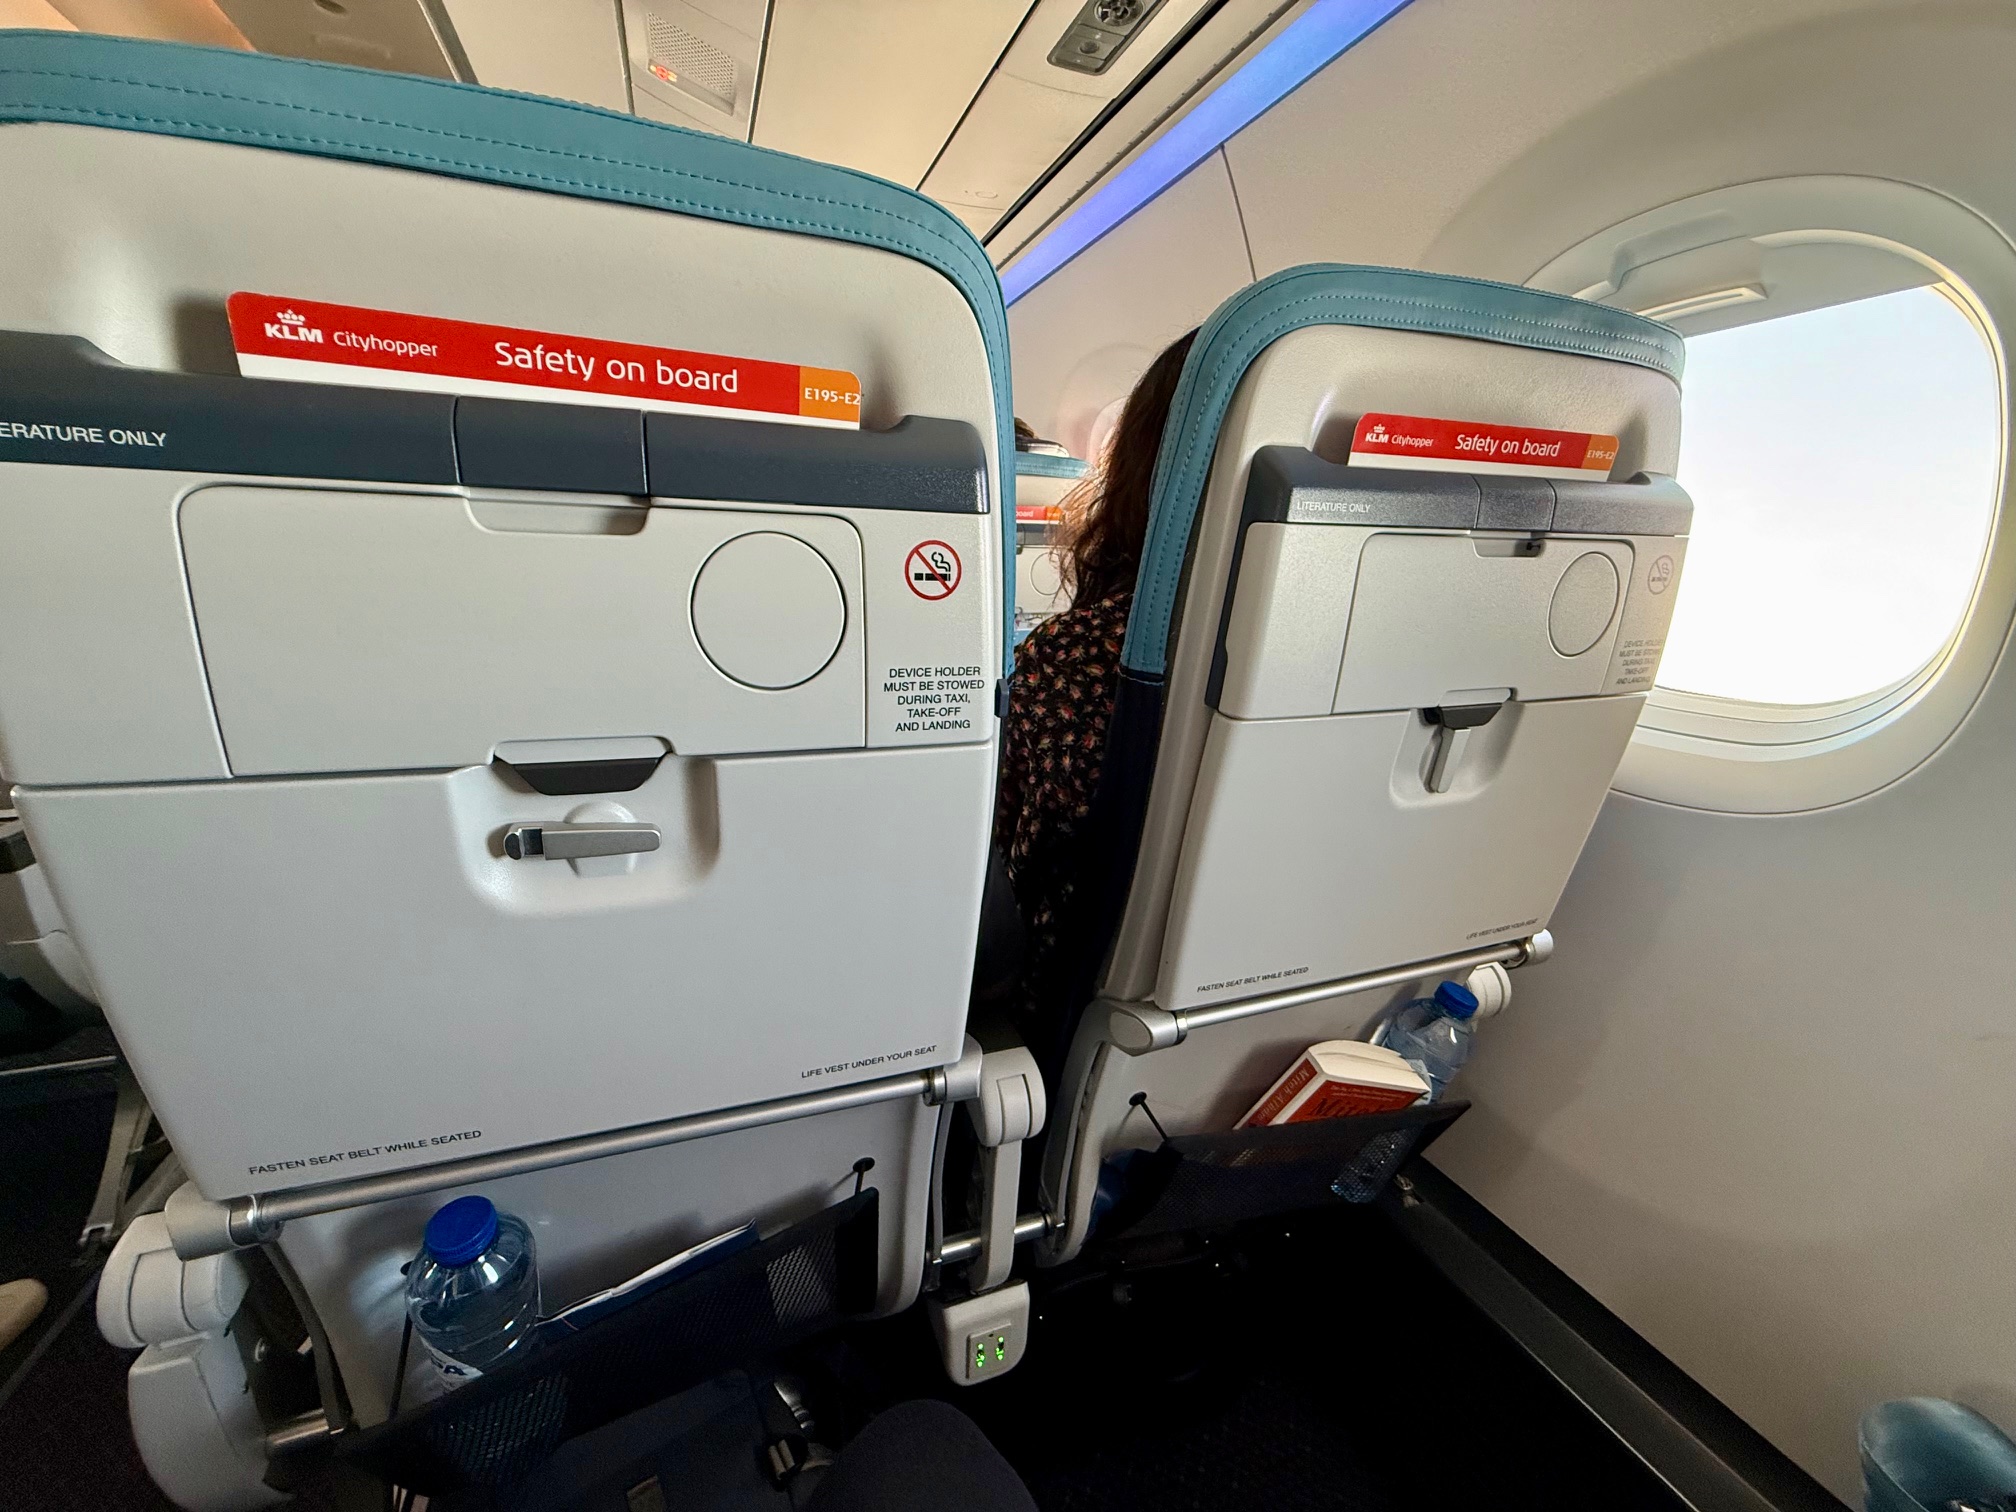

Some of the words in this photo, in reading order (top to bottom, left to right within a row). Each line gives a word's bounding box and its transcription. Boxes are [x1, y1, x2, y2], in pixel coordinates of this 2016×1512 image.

[264, 322, 324, 344] KLM
[333, 331, 438, 357] Cityhopper
[494, 341, 595, 382] Safety
[606, 358, 646, 383] on
[656, 359, 739, 393] board
[804, 387, 861, 406] E195-E2
[108, 429, 167, 447] ONLY
[1365, 431, 1389, 444] KLM
[1391, 434, 1434, 448] Cityhopper
[1454, 433, 1498, 456] Safety
[1501, 439, 1518, 454] on
[1521, 438, 1562, 458] board
[1586, 450, 1614, 460] E195-E2
[1296, 501, 1348, 512] LITERATURE
[1349, 503, 1371, 513] ONLY
[889, 667, 932, 678] DEVICE
[935, 666, 981, 677] HOLDER
[883, 681, 917, 692] MUST
[919, 680, 934, 691] BE
[937, 679, 985, 691] STOWED
[897, 694, 941, 705] DURING
[944, 693, 971, 704] TAXI,
[907, 706, 961, 718] TAKE-OFF
[895, 721, 919, 732] AND
[922, 719, 971, 731] LANDING
[1196, 982, 1225, 993] FASTEN
[1225, 978, 1243, 988] SEAT
[1243, 975, 1261, 985] BELT
[1261, 971, 1282, 981] WHILE
[1282, 966, 1309, 977] SEATED
[801, 1067, 823, 1079] LIFE
[824, 1062, 850, 1074] VEST
[851, 1056, 885, 1069] UNDER
[886, 1050, 912, 1062] YOUR
[914, 1044, 937, 1056] SEAT
[249, 1159, 306, 1175] FASTEN
[309, 1152, 346, 1166] SEAT
[348, 1146, 383, 1160] BELT
[385, 1139, 428, 1154] WHILE
[430, 1129, 482, 1146] SEATED
